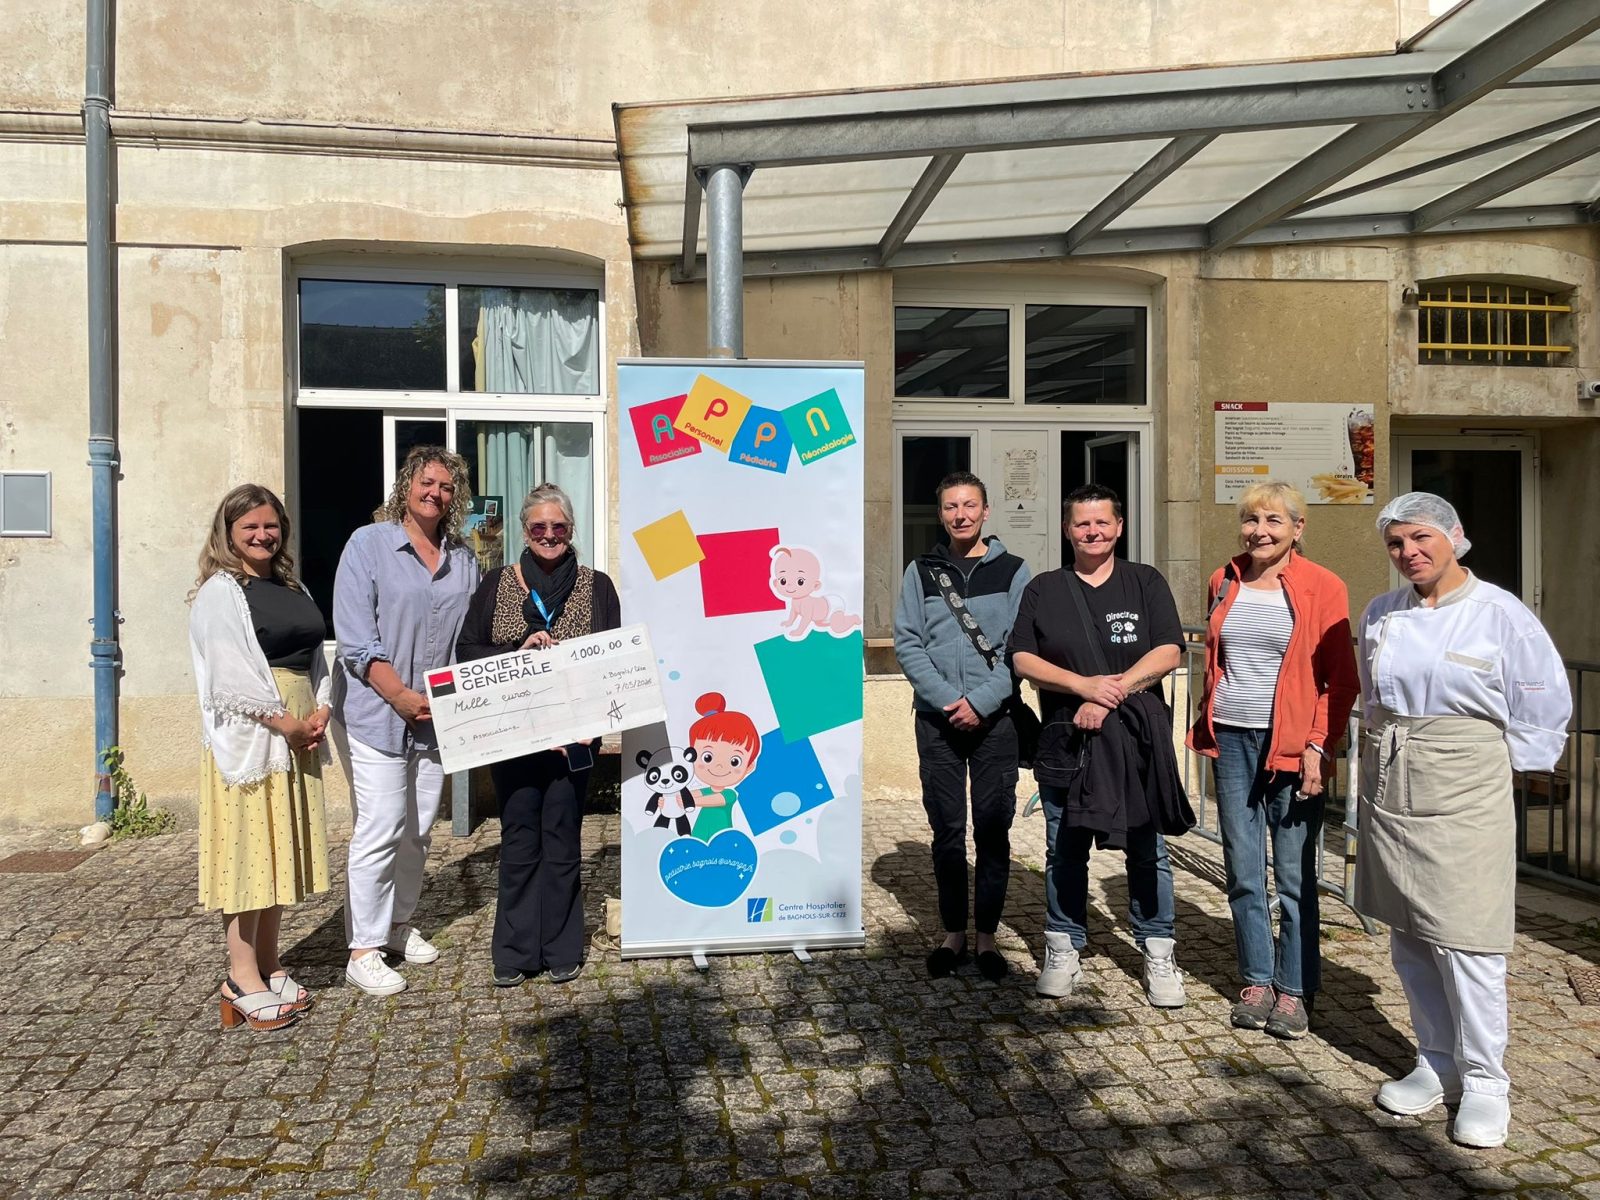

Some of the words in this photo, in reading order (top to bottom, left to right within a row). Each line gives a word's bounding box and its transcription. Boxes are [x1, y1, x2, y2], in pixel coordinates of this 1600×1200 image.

[651, 414, 675, 443] A
[703, 398, 729, 421] P
[754, 421, 777, 448] P
[684, 422, 724, 446] Personnel
[649, 446, 695, 463] Association
[740, 452, 777, 468] Pédiatrie
[1222, 466, 1255, 474] BOISSONS
[1111, 634, 1121, 643] de
[1123, 633, 1138, 643] site
[459, 653, 533, 679] SOCIETE
[462, 662, 552, 691] GENERALE
[454, 697, 492, 714] Mille
[502, 689, 532, 702] euros
[458, 736, 466, 746] 3
[806, 901, 847, 911] Hospitalier
